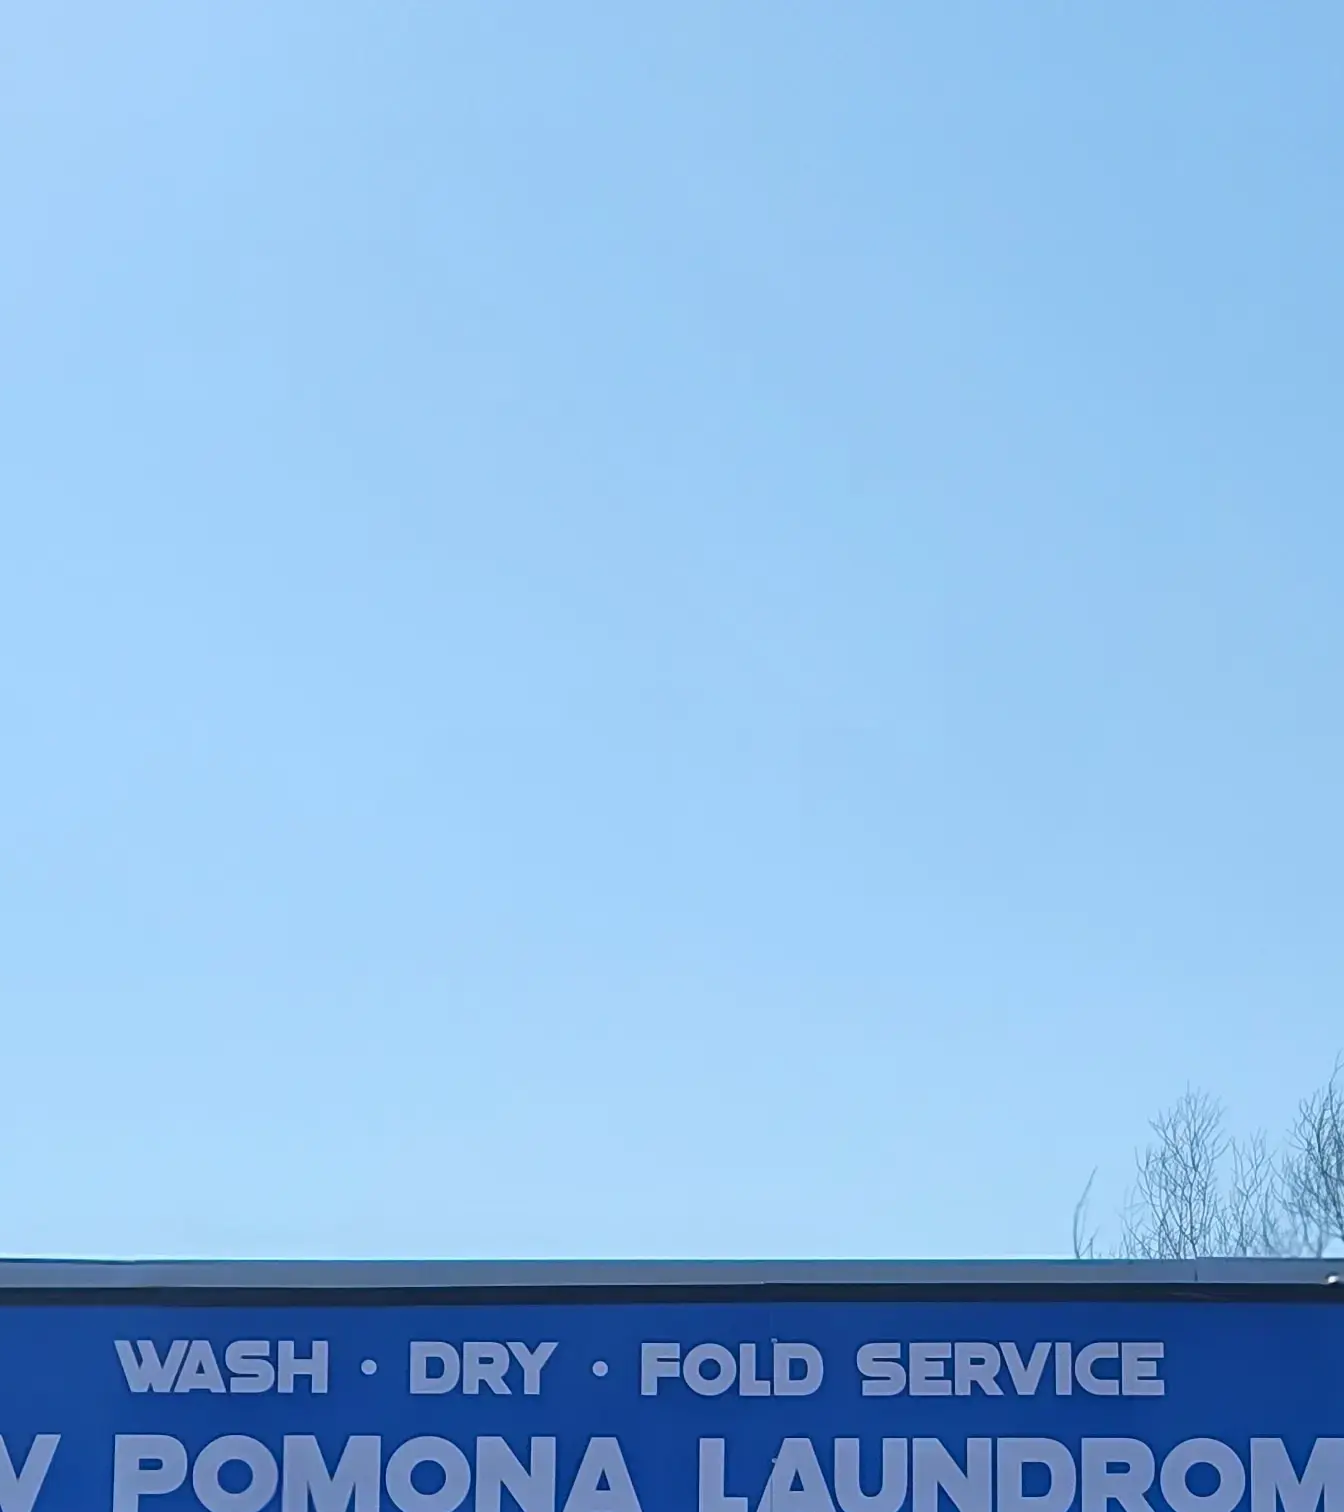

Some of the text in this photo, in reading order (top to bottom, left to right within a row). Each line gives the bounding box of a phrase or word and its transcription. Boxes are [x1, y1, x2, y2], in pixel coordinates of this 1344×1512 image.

[114, 1338, 1166, 1398] WASH DRY FOLD SERVICE
